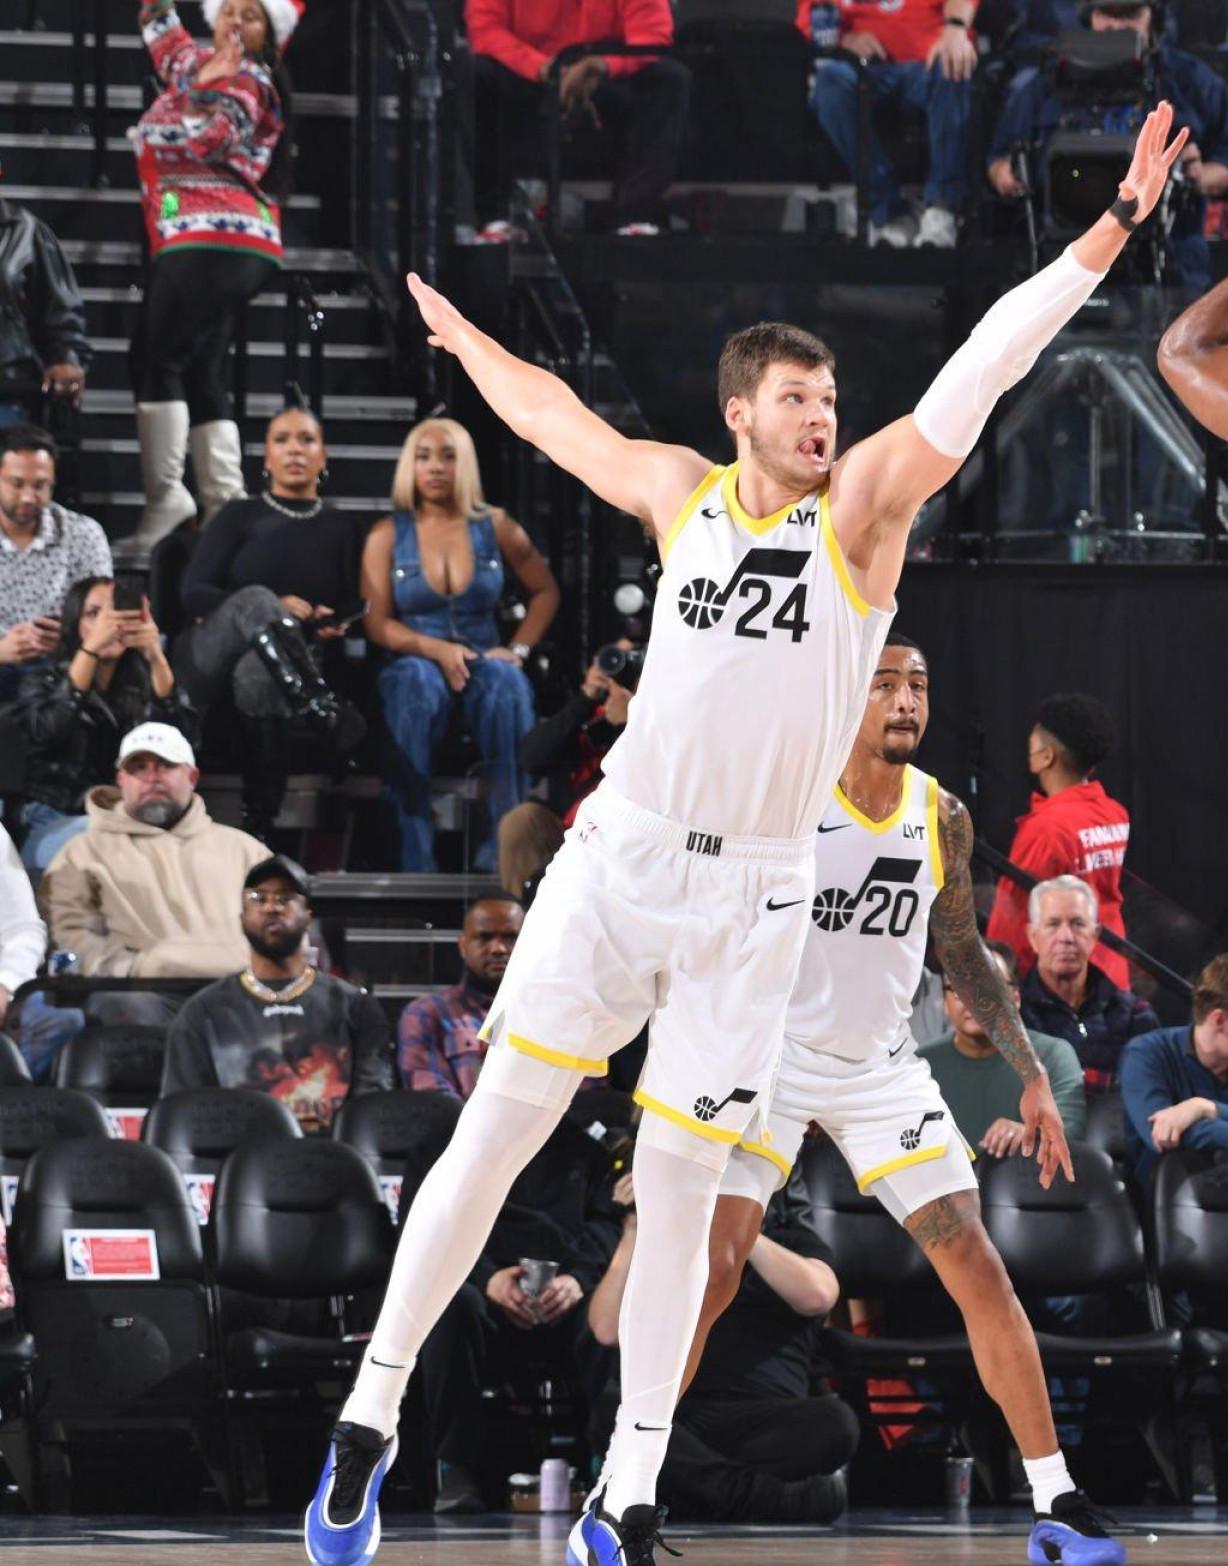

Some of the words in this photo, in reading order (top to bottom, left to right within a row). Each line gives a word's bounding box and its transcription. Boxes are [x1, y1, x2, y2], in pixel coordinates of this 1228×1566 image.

[735, 578, 811, 643] 24
[686, 830, 723, 857] UTAH
[860, 885, 920, 938] 20
